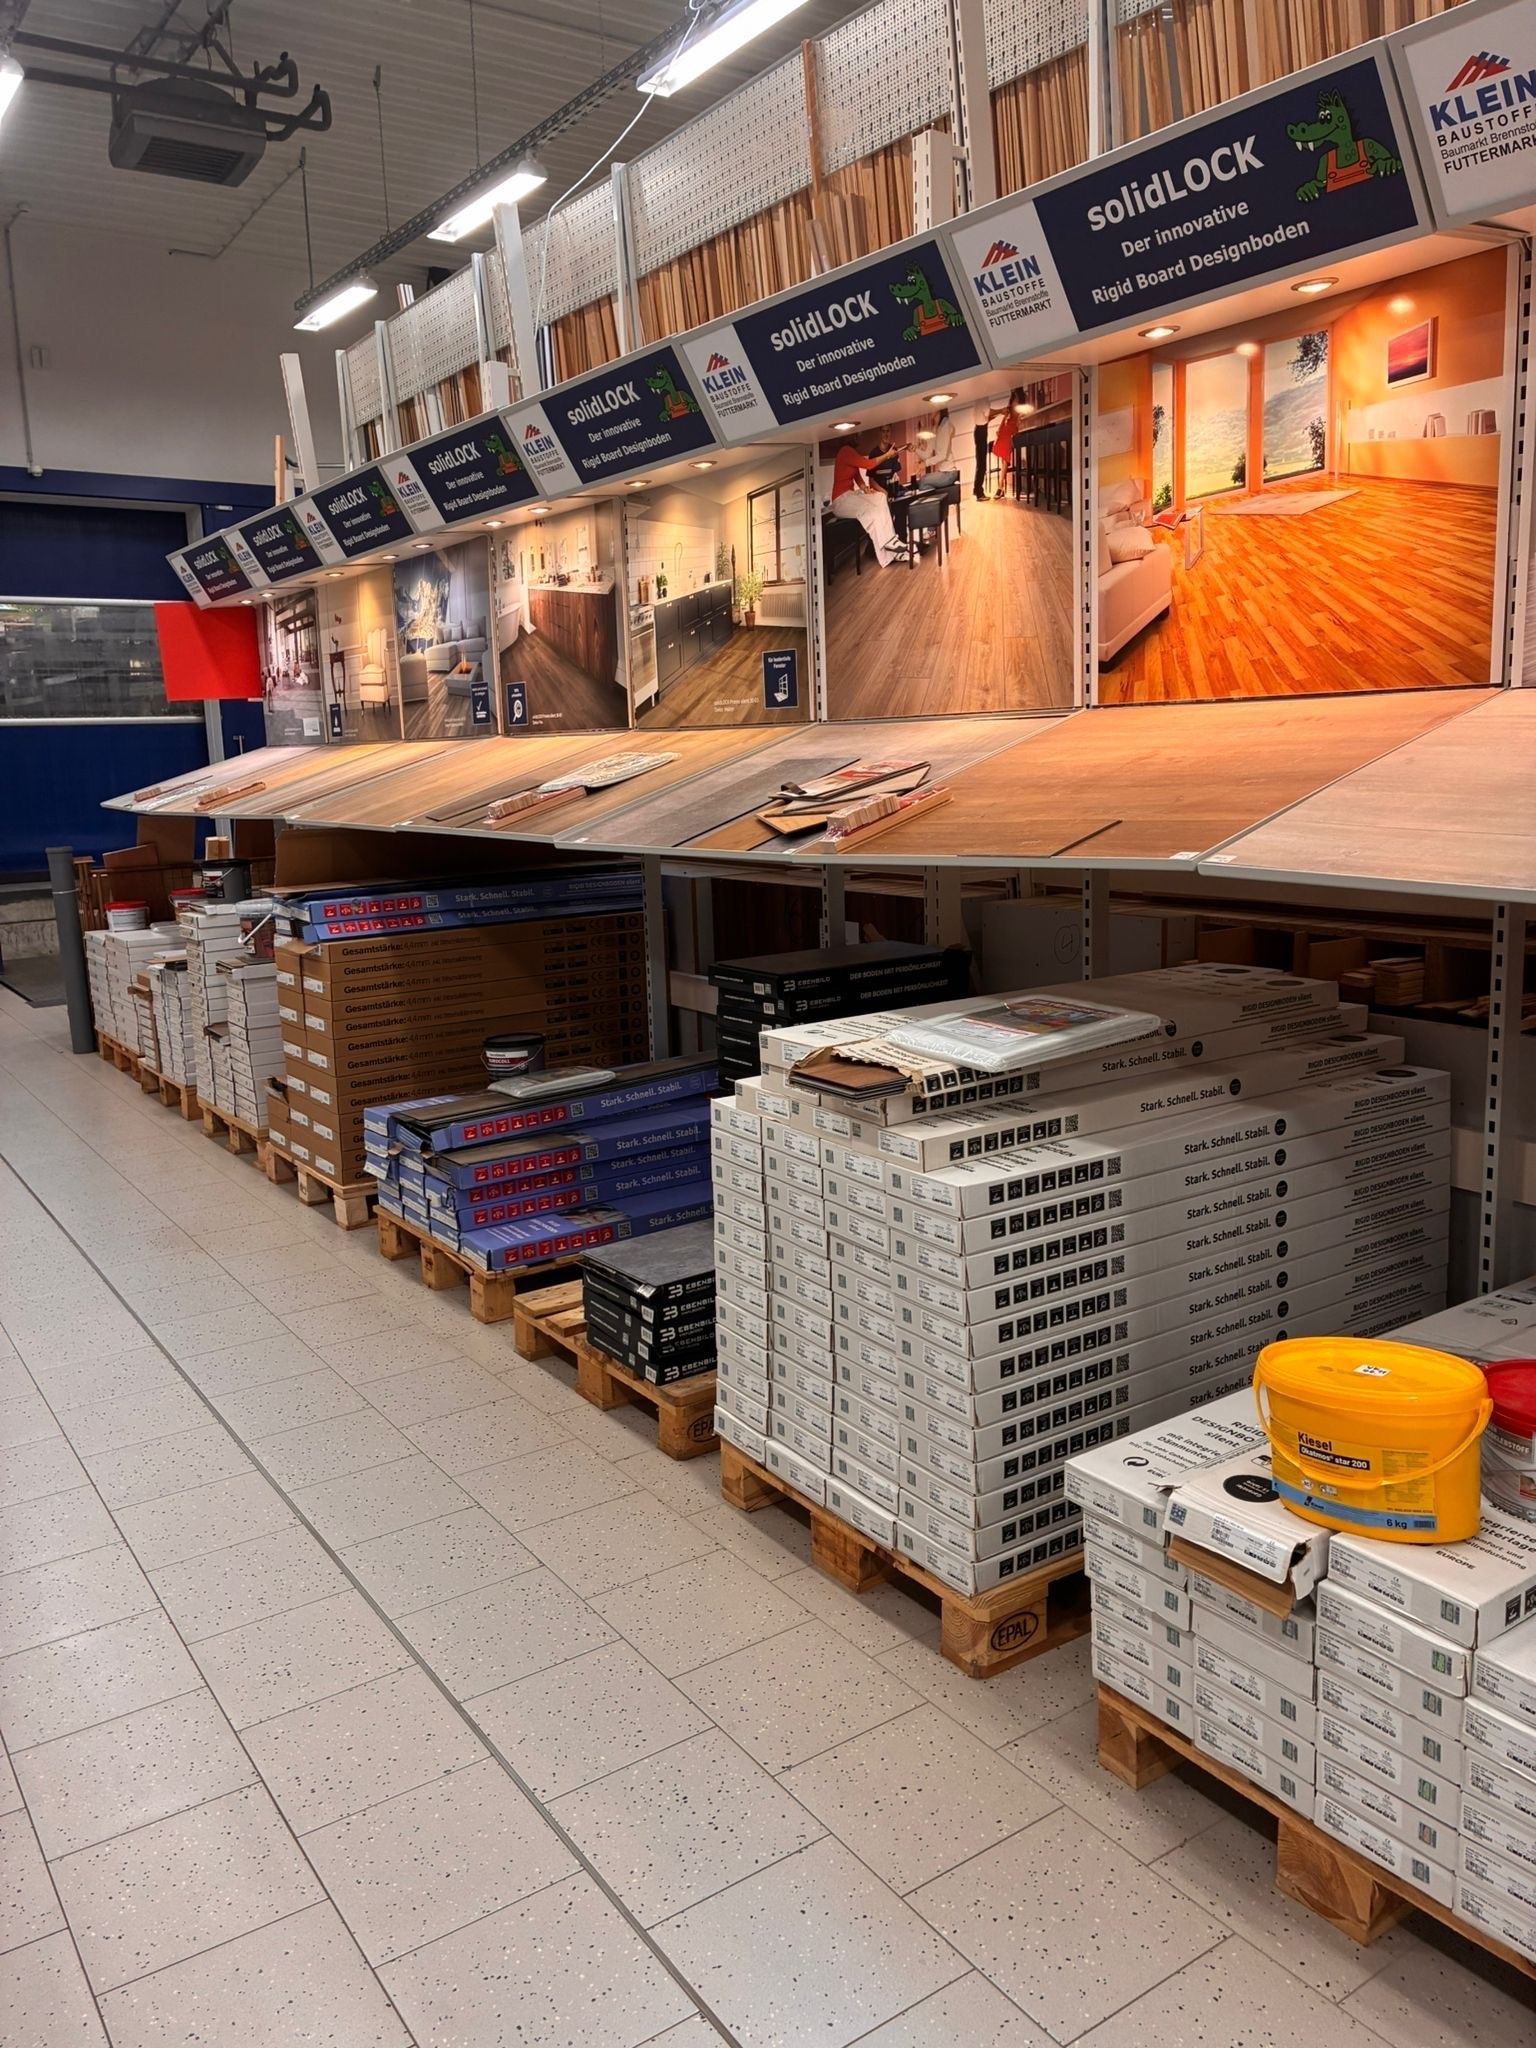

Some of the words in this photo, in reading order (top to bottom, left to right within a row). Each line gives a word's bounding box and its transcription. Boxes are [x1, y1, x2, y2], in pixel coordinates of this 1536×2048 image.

[1429, 69, 1536, 131] KLEIN
[1437, 103, 1536, 147] BAUSTOFF
[1440, 137, 1489, 160] Baumarkt
[1490, 121, 1536, 144] Brennsto
[1444, 134, 1536, 174] FUTTERMAR
[1087, 135, 1265, 231] solidLOCK
[1121, 235, 1151, 257] Der
[1154, 201, 1249, 246] innovative
[973, 255, 1041, 296] KLEIN
[1091, 278, 1133, 304] Rigid
[1136, 259, 1186, 289] Board
[1189, 221, 1310, 271] Designboden
[981, 278, 1046, 308] BAUSTOFFE
[985, 302, 1014, 318] Baumarkt
[1014, 289, 1049, 308] Brennstoffe
[770, 290, 879, 352] solidLOCK
[989, 298, 1052, 328] FUTTERMARKT
[796, 357, 816, 373] Der
[818, 336, 876, 366] innovative
[702, 365, 747, 394] KLEIN
[709, 382, 752, 403] BAUSTOFFE
[782, 388, 808, 406] Rigid
[809, 376, 842, 397] Board
[843, 355, 916, 386] Designboden
[567, 381, 641, 426] solidLOCK
[717, 399, 758, 418] FUTTERMARKT
[588, 431, 602, 443] Der
[603, 417, 642, 438] innovative
[428, 441, 482, 475] solidLOCK
[522, 435, 556, 457] KLEIN
[582, 456, 600, 470] Rigid
[600, 445, 623, 462] Board
[623, 432, 672, 454] Designboden
[328, 487, 368, 516] solidLOCK
[397, 481, 422, 498] KLEIN
[252, 523, 285, 547] solidLOCK
[455, 892, 479, 903] Stark.
[480, 889, 510, 900] Schnell.
[511, 888, 535, 898] Stabil.
[342, 944, 403, 956] Gesamtstärke:
[344, 963, 404, 976] Gesamtstärke:
[344, 981, 405, 994] Gesamtstärke:
[345, 1000, 406, 1014] Gesamtstärke:
[346, 1018, 407, 1032] Gesamtstärke:
[348, 1037, 408, 1052] Gesamtstärke:
[347, 1055, 408, 1070] Gesamtstärke:
[1102, 1057, 1127, 1072] Stark.
[1128, 1051, 1160, 1067] Schnell.
[1162, 1047, 1187, 1060] Stabil.
[350, 1074, 410, 1089] Gesamtstärke:
[600, 1097, 625, 1108] Stark.
[625, 1088, 657, 1102] Schnell.
[658, 1081, 682, 1095] Stabil.
[350, 1092, 411, 1107] Gesamtstärke:
[1140, 1098, 1165, 1113] Stark.
[1167, 1091, 1198, 1107] Schnell.
[1200, 1085, 1225, 1099] Stabil.
[616, 1139, 641, 1150] Stark.
[642, 1131, 675, 1145] Schnell.
[676, 1125, 701, 1138] Stabil.
[1184, 1140, 1209, 1155] Stark.
[1211, 1131, 1243, 1148] Schnell.
[1244, 1125, 1270, 1140] Stabil.
[611, 1158, 636, 1170] Stark.
[637, 1151, 669, 1165] Schnell.
[670, 1146, 696, 1158] Stabil.
[1185, 1171, 1210, 1186] Stark.
[1211, 1163, 1243, 1180] Schnell.
[1245, 1156, 1270, 1171] Stabil.
[615, 1179, 641, 1191] Stark.
[641, 1172, 674, 1185] Schnell.
[675, 1165, 701, 1178] Stabil.
[650, 1213, 675, 1227] Stark.
[676, 1206, 709, 1221] Schnell.
[1187, 1205, 1212, 1219] Stark.
[1213, 1195, 1245, 1212] Schnell.
[1246, 1188, 1272, 1203] Stabil.
[1186, 1235, 1212, 1250] Stark.
[1213, 1226, 1244, 1243] Schnell.
[1246, 1218, 1271, 1233] Stabil.
[1188, 1267, 1213, 1282] Stark.
[1214, 1258, 1246, 1275] Schnell.
[1248, 1249, 1272, 1264] Stabil.
[680, 1297, 715, 1312] EBENBIL
[1189, 1300, 1214, 1314] Stark.
[1215, 1290, 1246, 1306] Schnell.
[1248, 1280, 1272, 1295] Stabil.
[1190, 1330, 1214, 1345] Stark.
[1216, 1319, 1247, 1336] Schnell.
[1248, 1309, 1273, 1325] Stabil.
[681, 1357, 716, 1372] EBENBIL
[1189, 1361, 1214, 1376] Stark.
[1215, 1349, 1246, 1366] Schnell.
[1190, 1391, 1214, 1406] Stark.
[1215, 1378, 1246, 1397] Schnell.
[1191, 1416, 1255, 1443] DESIGNBO
[1204, 1431, 1240, 1448] silent
[1231, 1421, 1266, 1437] RIGID
[1297, 1431, 1332, 1452] Kiesel
[1157, 1436, 1212, 1461] Dämmunter
[1166, 1432, 1183, 1441] mit
[1184, 1438, 1222, 1457] integrie
[1335, 1457, 1351, 1466] star
[1351, 1459, 1368, 1469] 200
[1386, 1518, 1394, 1527] 6
[1395, 1520, 1408, 1530] kg
[1436, 1550, 1476, 1570] EUROPE
[1506, 1549, 1524, 1560] und
[998, 1618, 1031, 1647] EPAL
